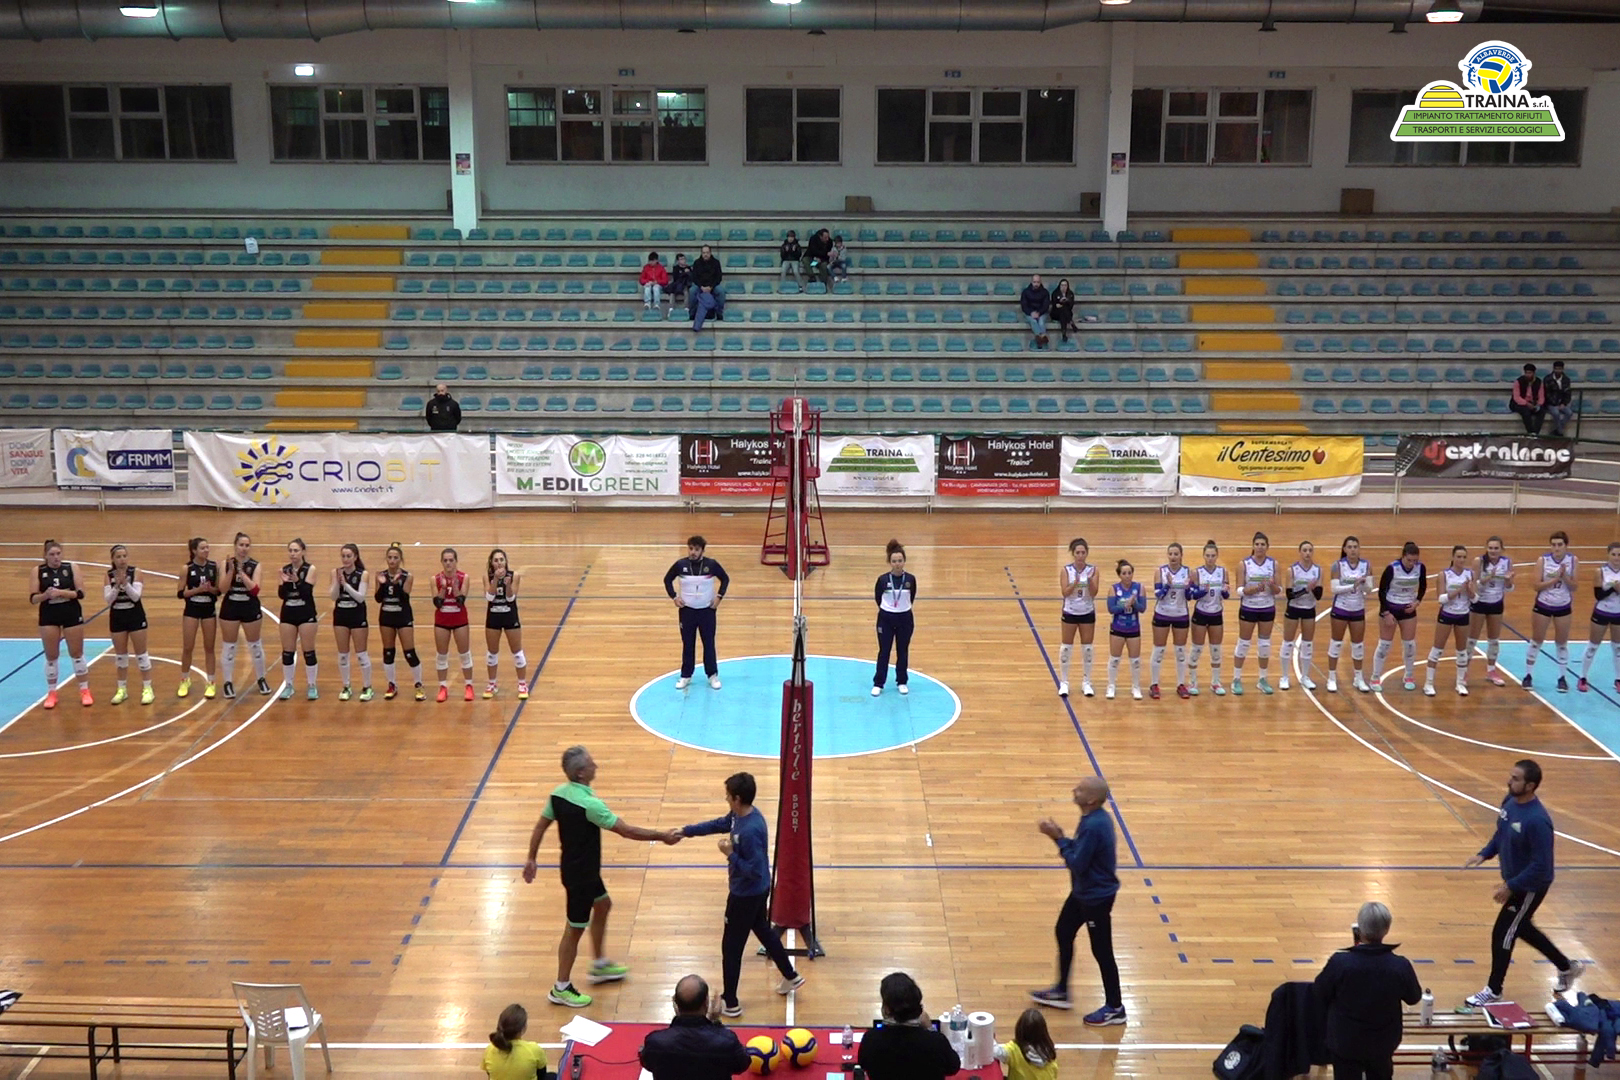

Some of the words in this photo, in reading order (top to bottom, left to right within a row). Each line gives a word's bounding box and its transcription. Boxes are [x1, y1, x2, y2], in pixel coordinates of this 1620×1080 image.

[730, 439, 769, 451] Halykos
[987, 440, 1026, 451] Halykos
[1028, 440, 1055, 450] Hotel
[866, 448, 904, 457] TRAINA
[1111, 449, 1148, 458] TRAINA
[1217, 446, 1229, 462] il
[1229, 440, 1311, 463] Centesimo
[128, 453, 172, 467] FRIMM
[516, 476, 659, 492] M-EDILGREEN
[53, 577, 60, 587] 3
[388, 586, 394, 595] 5
[447, 587, 453, 595] 7
[791, 794, 799, 833] SPORT
